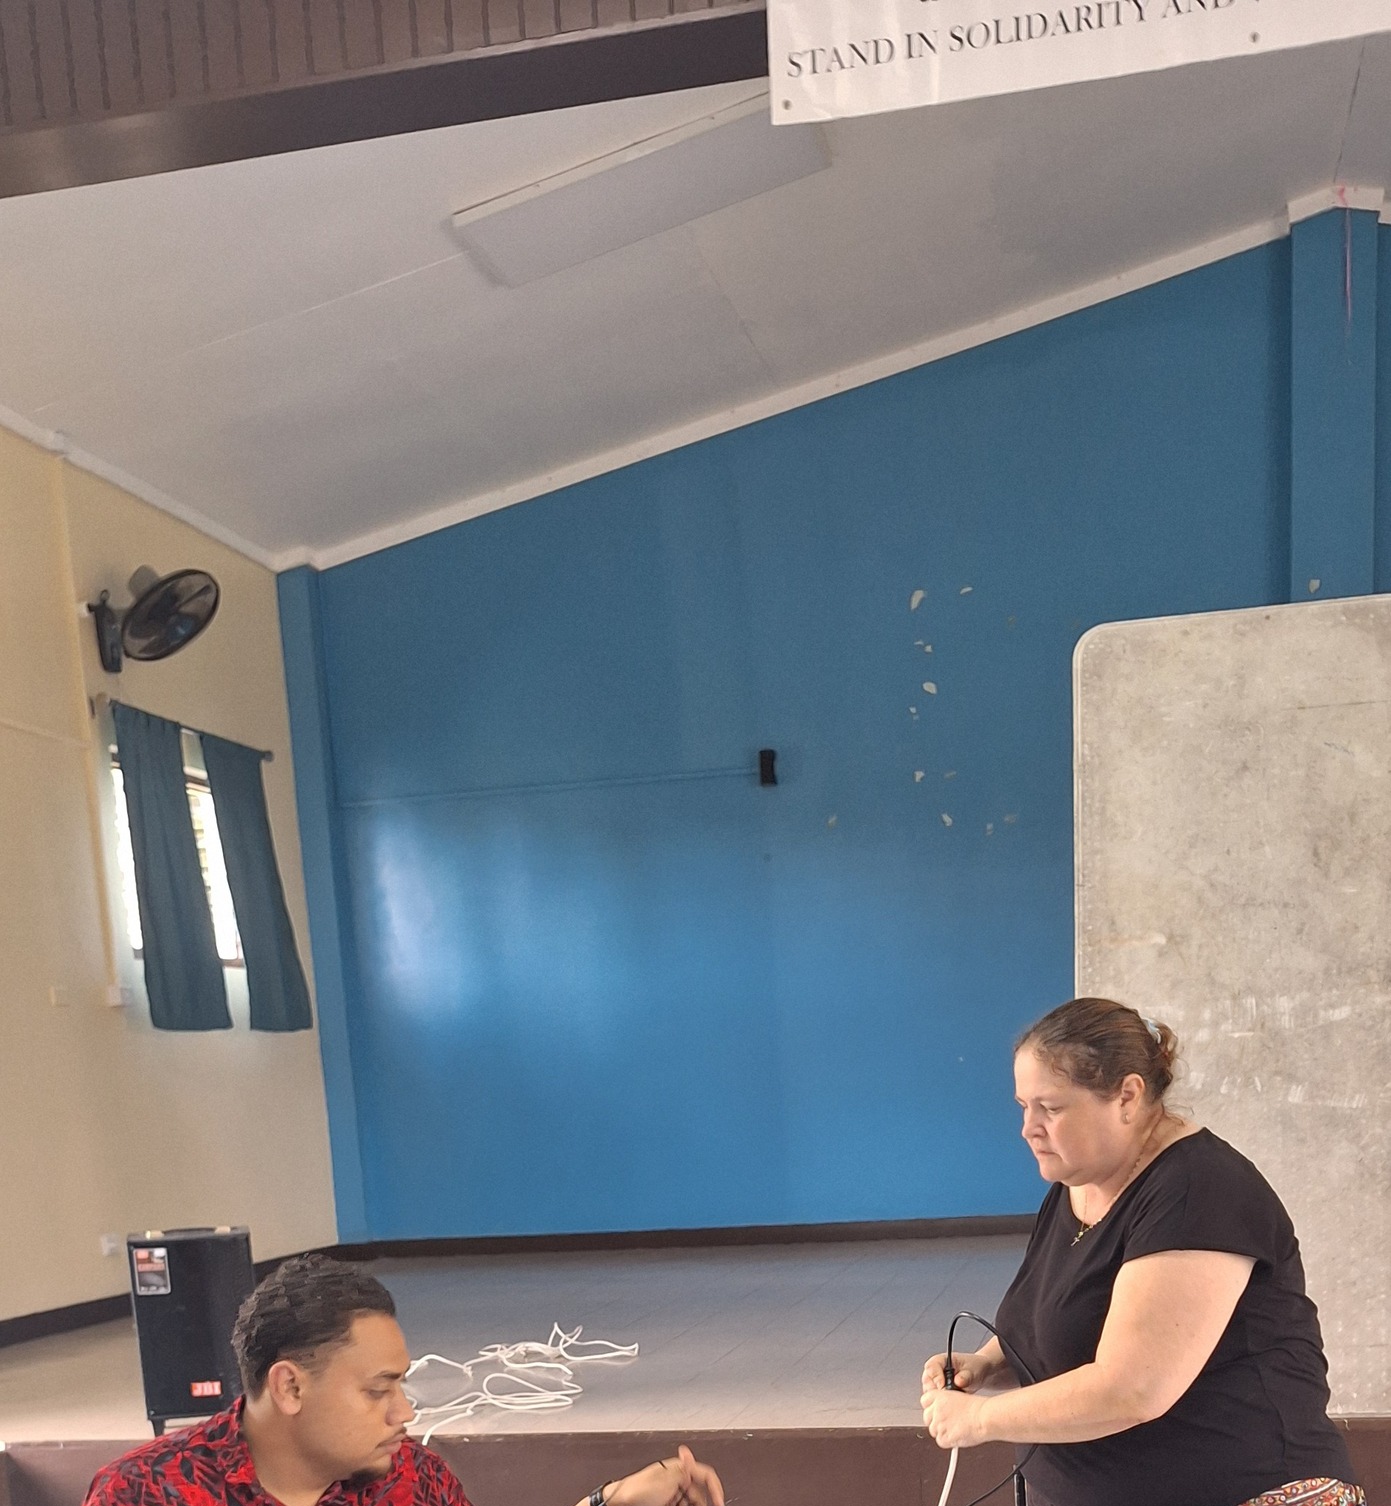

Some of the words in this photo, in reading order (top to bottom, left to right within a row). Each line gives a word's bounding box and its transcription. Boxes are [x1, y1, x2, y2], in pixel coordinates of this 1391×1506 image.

[787, 37, 896, 78] STAND
[904, 30, 939, 60] IN
[948, 0, 1152, 52] SOLIDARITY
